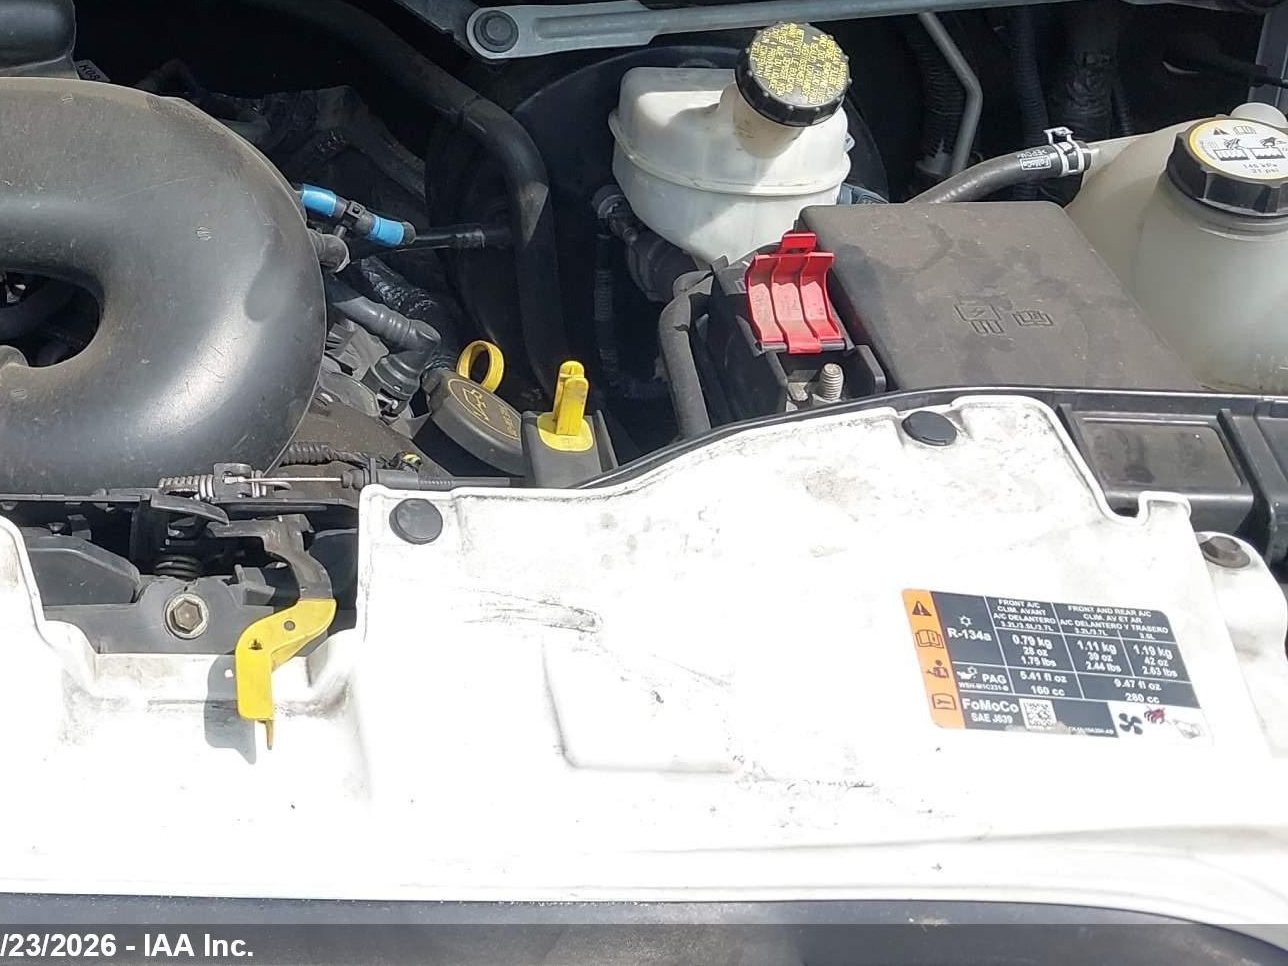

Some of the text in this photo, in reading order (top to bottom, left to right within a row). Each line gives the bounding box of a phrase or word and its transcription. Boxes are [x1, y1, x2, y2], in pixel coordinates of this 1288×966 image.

[998, 599, 1025, 608] FRONT
[1068, 605, 1095, 613] FRONT
[1008, 615, 1056, 624] DELANTERO
[1075, 620, 1122, 630] DELANTERO
[1132, 624, 1168, 633] TRASERO
[946, 627, 992, 641] R-134a
[1012, 634, 1053, 650] 0.79 kg
[1023, 647, 1035, 655] 28
[1077, 640, 1117, 655] 1.11 kg
[1133, 644, 1173, 660] 1.19 kg
[1021, 656, 1057, 667] 1.75 lbs
[1087, 652, 1099, 661] 39
[1144, 657, 1156, 666] 42
[1086, 661, 1122, 673] 2.44 lbs
[1142, 666, 1178, 678] 2.63 lbs
[982, 674, 1007, 684] PAG
[1020, 671, 1041, 681] 5.41
[1044, 673, 1052, 681] fl
[1114, 679, 1135, 688] 9.47
[1138, 680, 1146, 689] fl
[1030, 686, 1050, 695] 160
[1125, 692, 1145, 702] 280
[962, 698, 1019, 713] FoMoCo
[970, 713, 1013, 724] SAE J639
